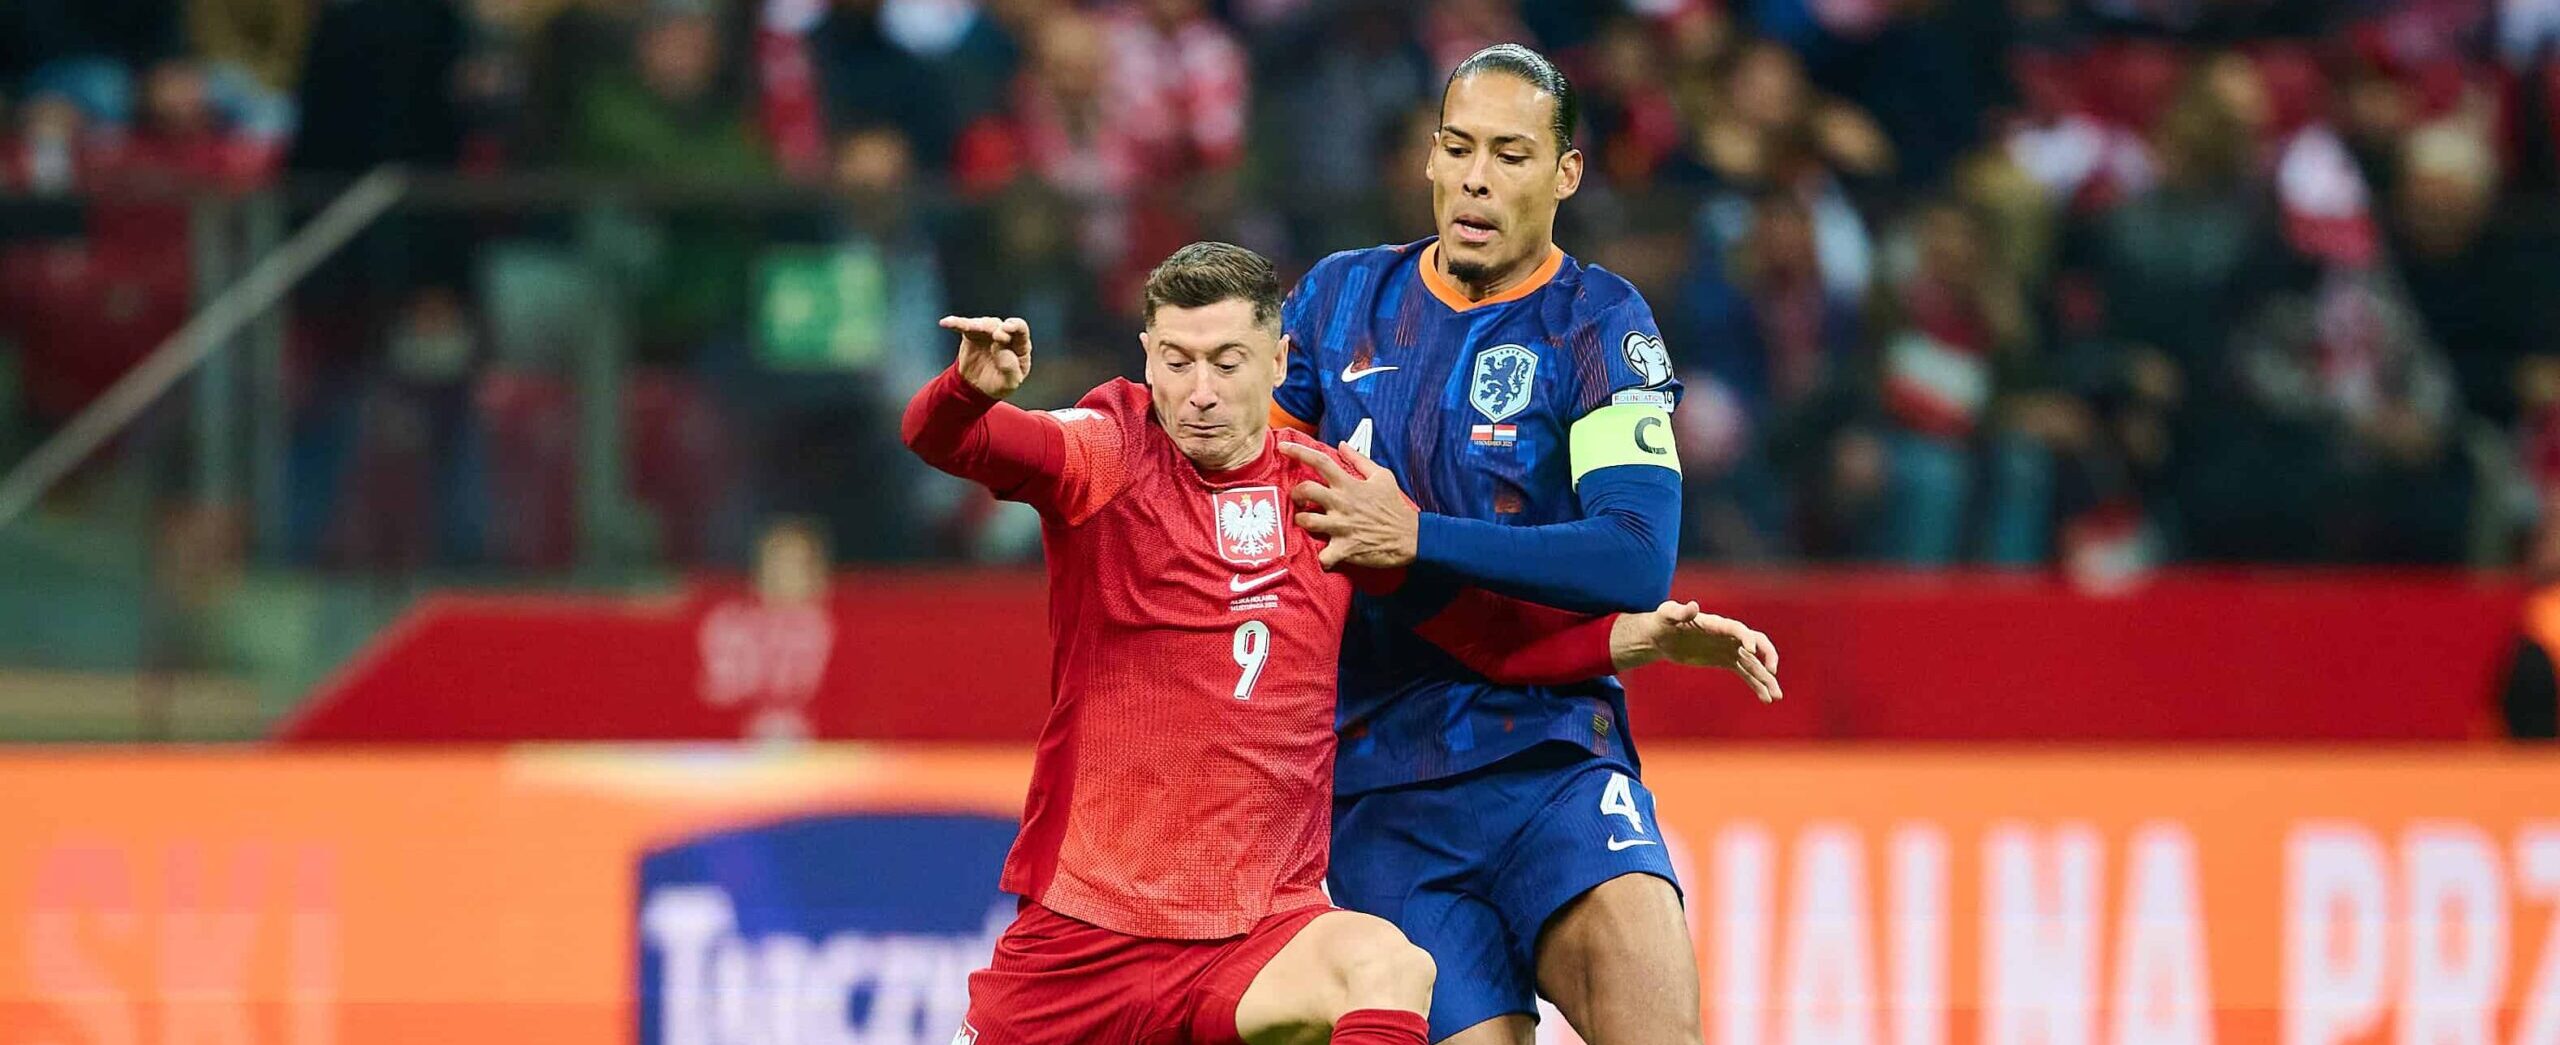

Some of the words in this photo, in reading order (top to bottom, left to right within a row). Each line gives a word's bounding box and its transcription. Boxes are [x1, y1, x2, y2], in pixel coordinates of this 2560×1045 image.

[1634, 416, 1667, 455] C
[1233, 620, 1269, 700] 9
[1600, 772, 1644, 835] 4
